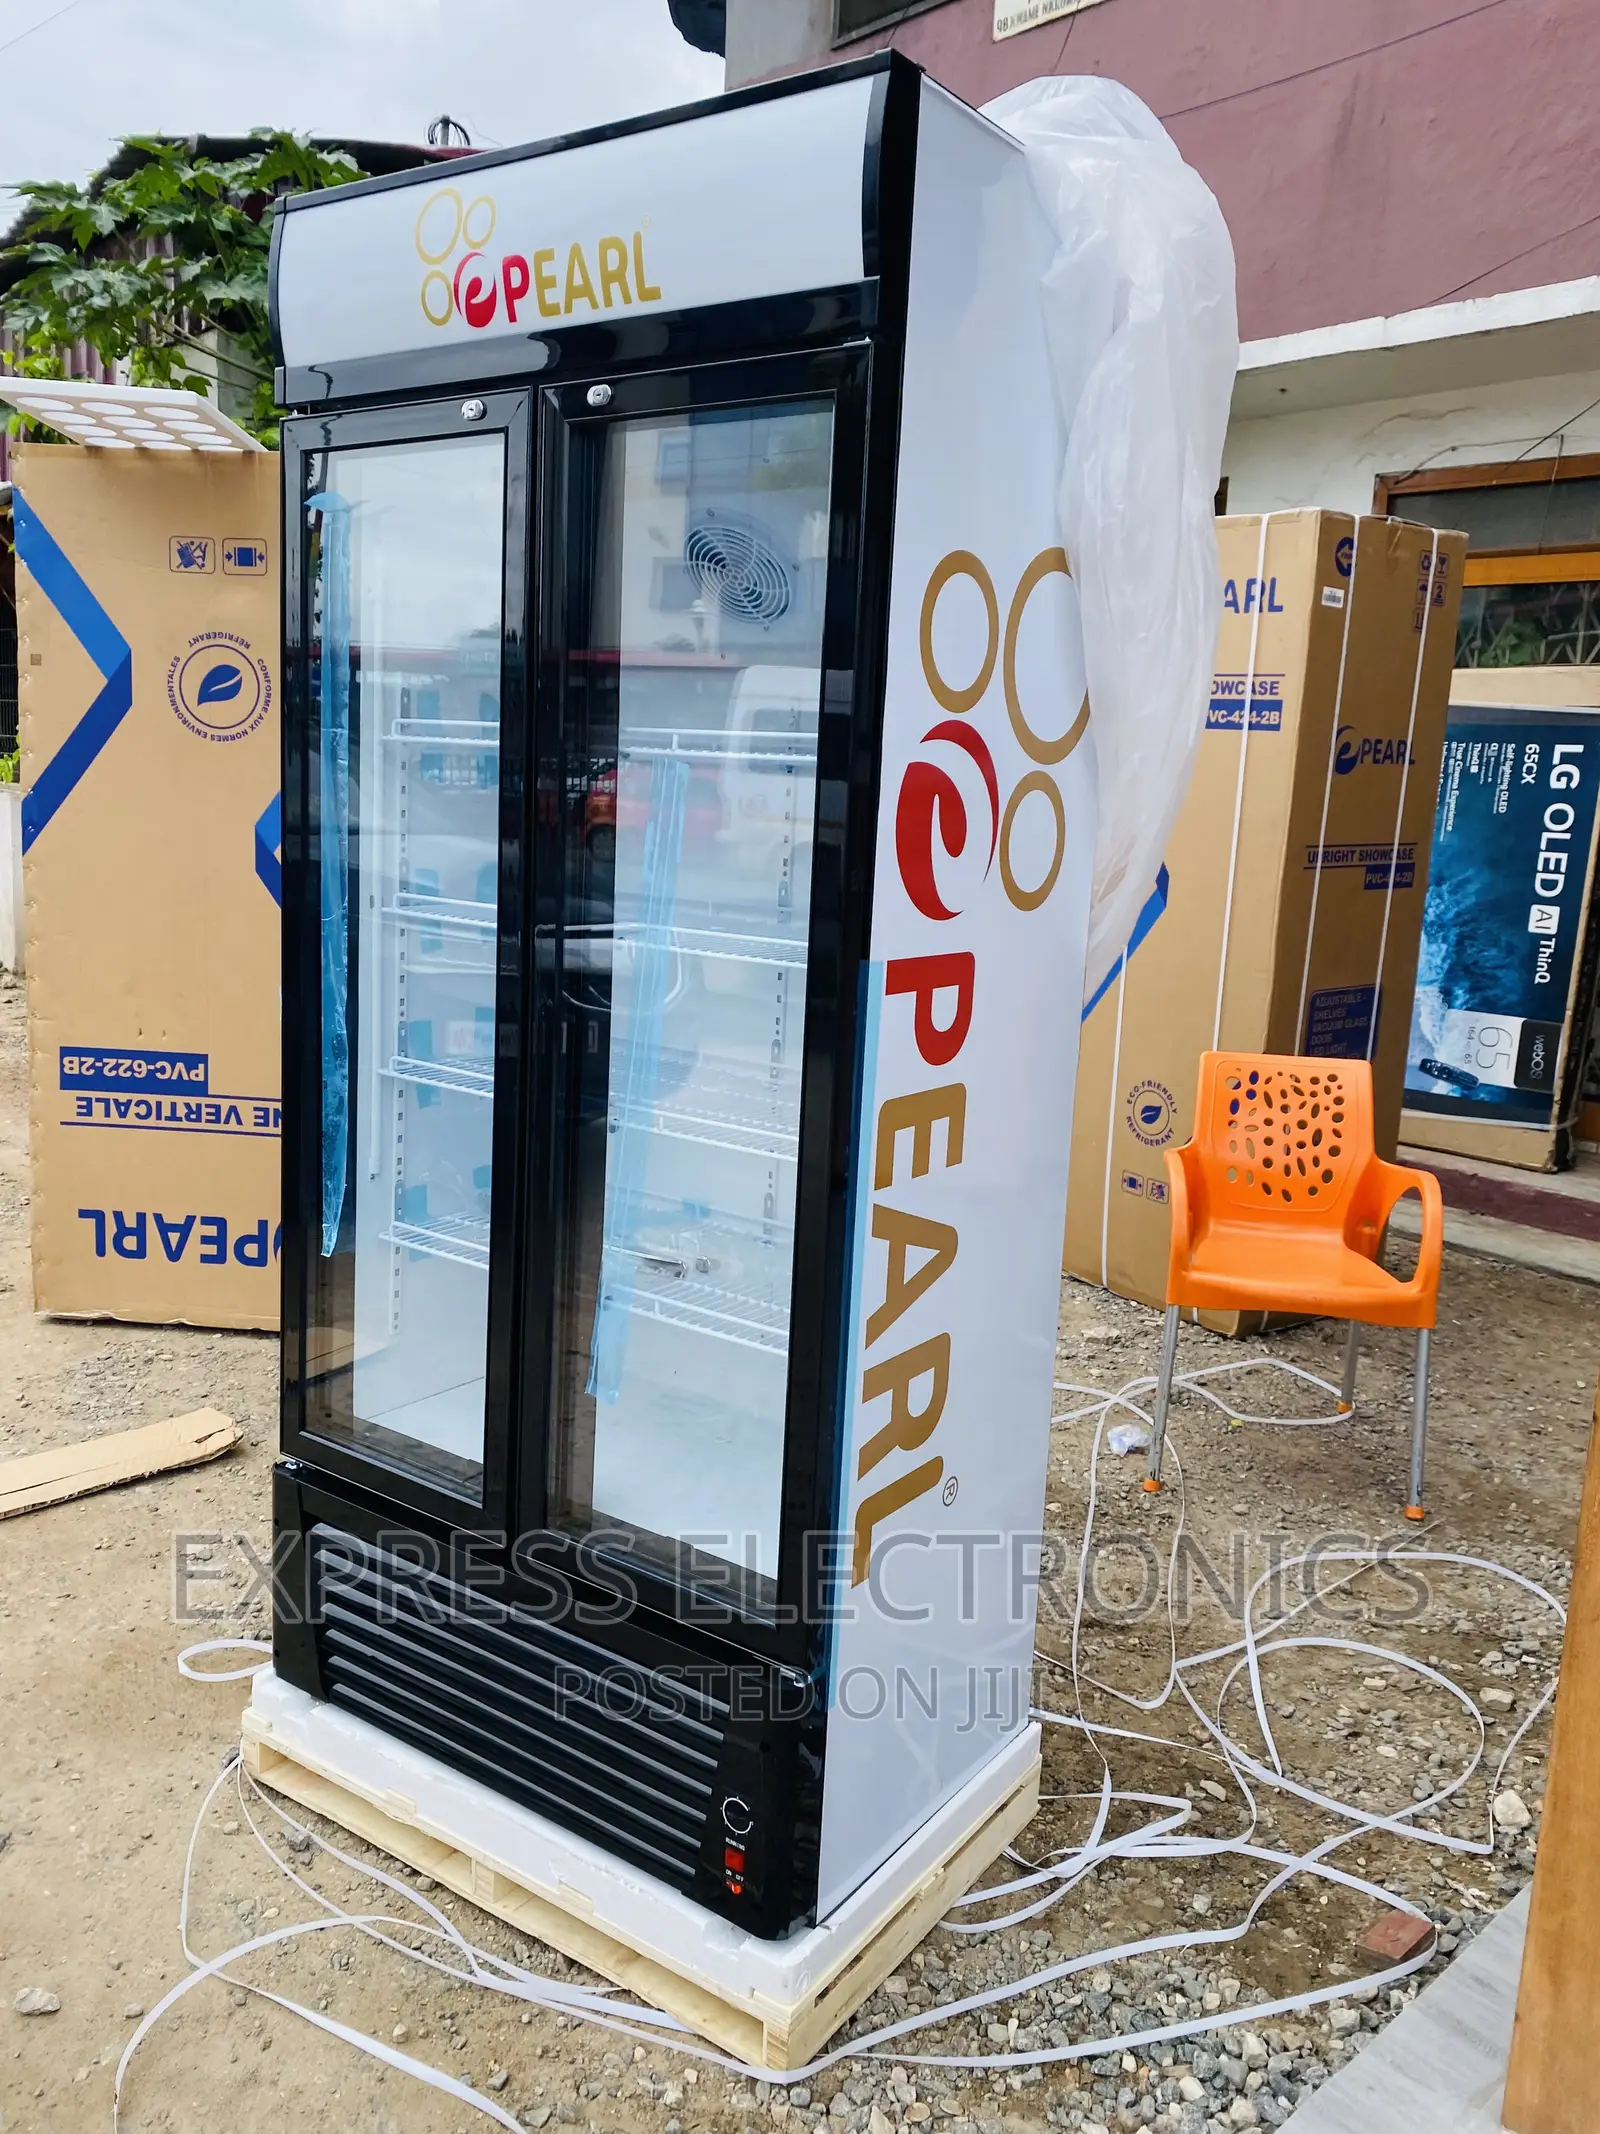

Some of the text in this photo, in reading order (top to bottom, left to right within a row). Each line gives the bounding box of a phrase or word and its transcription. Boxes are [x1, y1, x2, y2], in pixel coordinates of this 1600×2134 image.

[502, 231, 662, 323] PEARL
[257, 658, 272, 714] CONFORME
[210, 729, 249, 742] NORMES
[248, 713, 264, 732] AUX
[1360, 738, 1416, 765] PEARL
[1456, 742, 1466, 760] True
[1500, 743, 1516, 790] Self-lighting
[1521, 743, 1540, 785] 65CX
[1452, 761, 1463, 789] Cinema
[1446, 791, 1459, 832] Experience
[1498, 791, 1509, 814] OLED
[1366, 871, 1413, 885] PVC-44-2B
[1534, 744, 1584, 984] LG OLED AI ThinQ
[1475, 1026, 1514, 1070] 65
[1530, 1034, 1546, 1080] webOS
[62, 1055, 206, 1082] PVC-622-2B
[75, 1096, 244, 1127] VERTICALE
[1126, 1080, 1178, 1115] ECO-FRIENDLY
[1126, 1116, 1175, 1147] REFRIGERANT
[77, 1208, 269, 1268] PEARL
[851, 951, 975, 1589] PEARL
